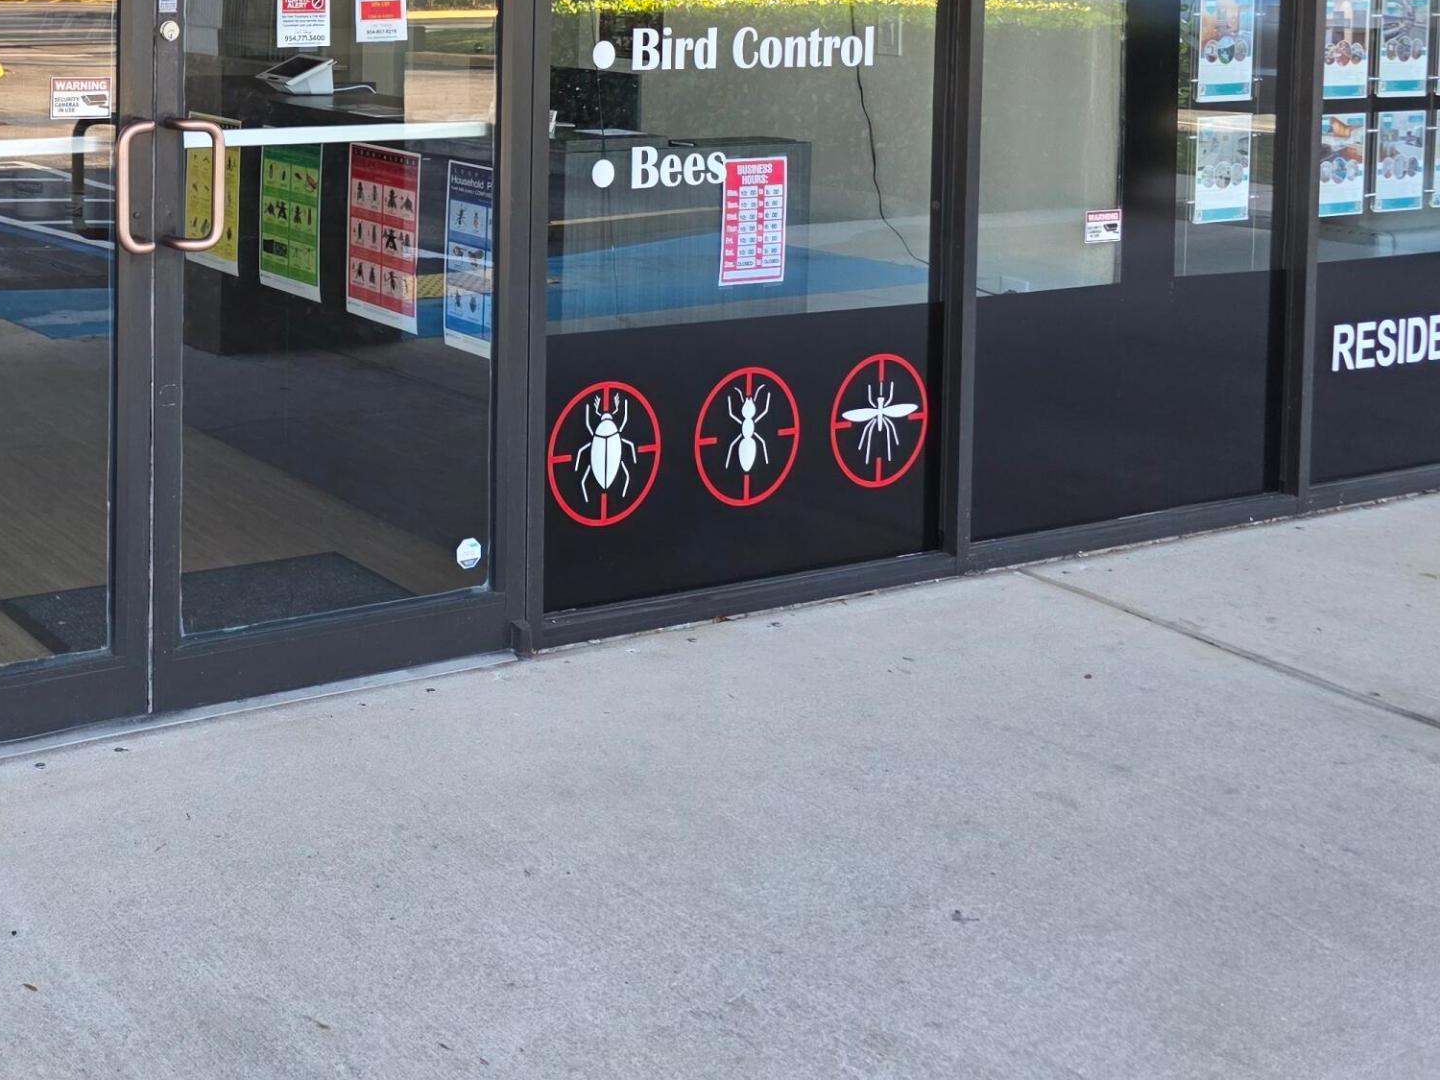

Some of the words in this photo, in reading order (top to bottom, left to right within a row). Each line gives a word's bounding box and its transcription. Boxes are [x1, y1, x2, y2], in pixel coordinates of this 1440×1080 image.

[631, 26, 718, 71] Bird
[732, 25, 875, 70] Control
[54, 81, 107, 90] WARNING
[630, 146, 727, 189] Bees
[737, 163, 773, 175] BUSINESS
[741, 174, 768, 185] HOURS:
